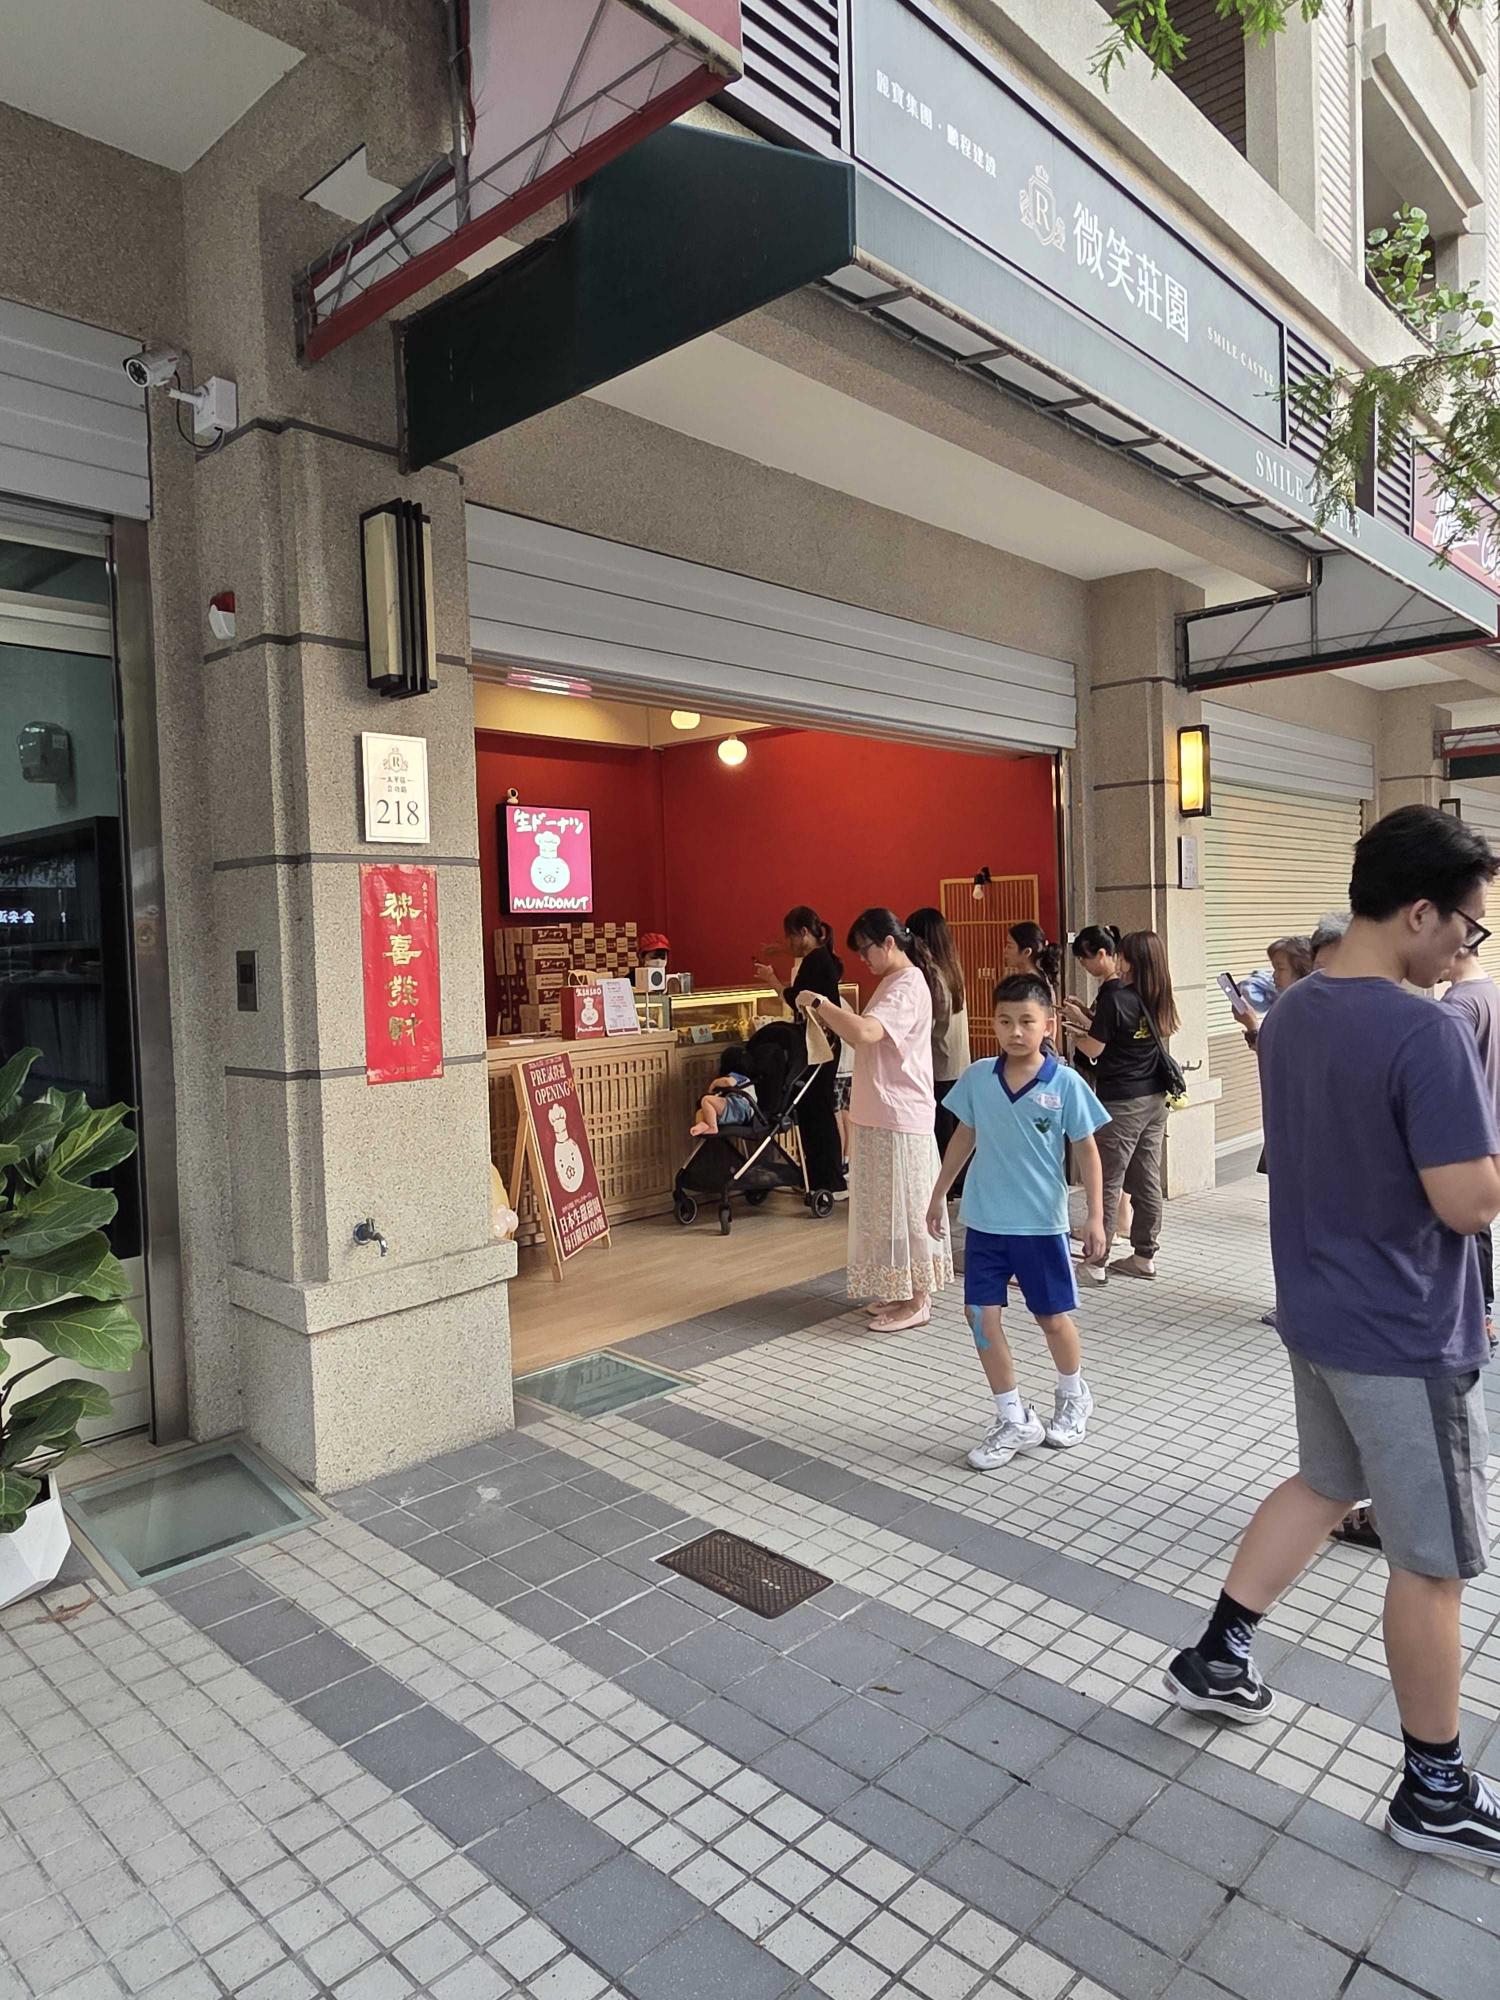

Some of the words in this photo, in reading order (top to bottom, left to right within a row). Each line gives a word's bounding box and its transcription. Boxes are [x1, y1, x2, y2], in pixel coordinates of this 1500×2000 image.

[1073, 201, 1189, 343] 微笑莊園
[1208, 326, 1238, 360] SMILE
[1241, 352, 1275, 388] CASTLE
[1255, 450, 1304, 503] SMILE
[376, 799, 420, 826] 218
[513, 808, 584, 835] 生ドーナツ
[513, 895, 589, 911] MUNIDONUT
[534, 1080, 571, 1106] OPENING
